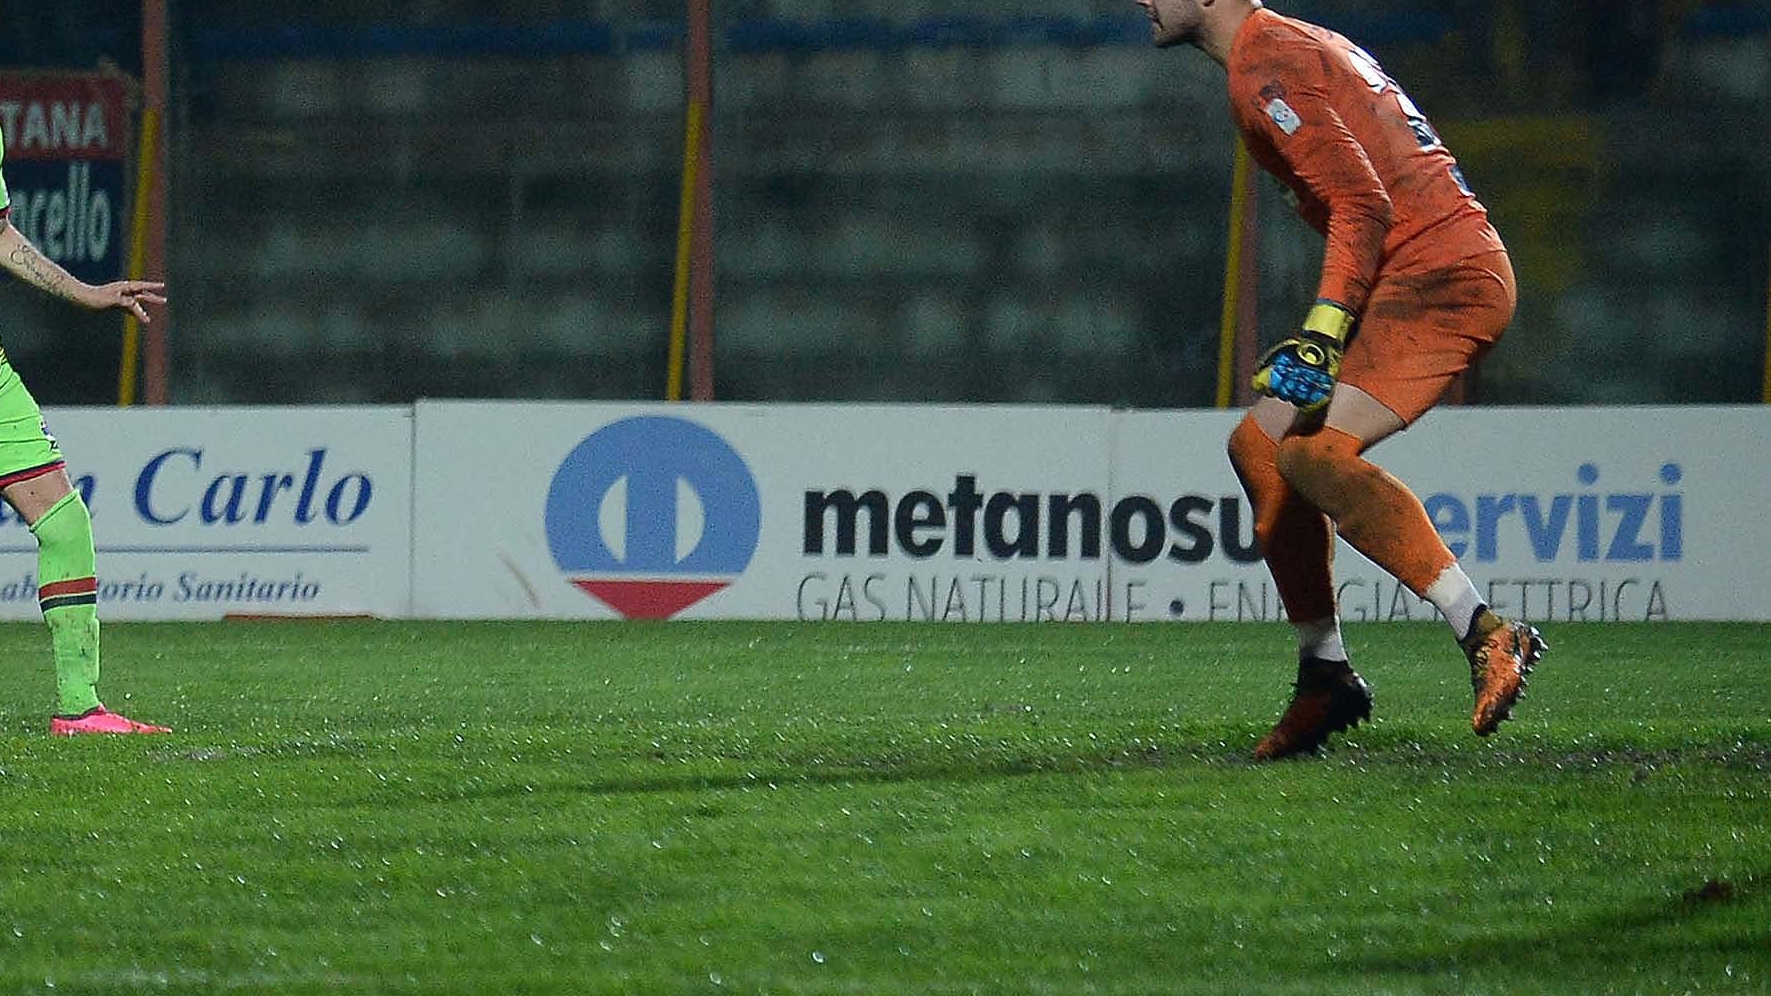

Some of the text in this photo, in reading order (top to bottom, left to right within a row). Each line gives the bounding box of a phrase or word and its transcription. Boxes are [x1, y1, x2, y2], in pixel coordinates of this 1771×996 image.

[134, 447, 374, 527] Carlo
[179, 569, 322, 605] Sanitario
[798, 573, 887, 621] GAS
